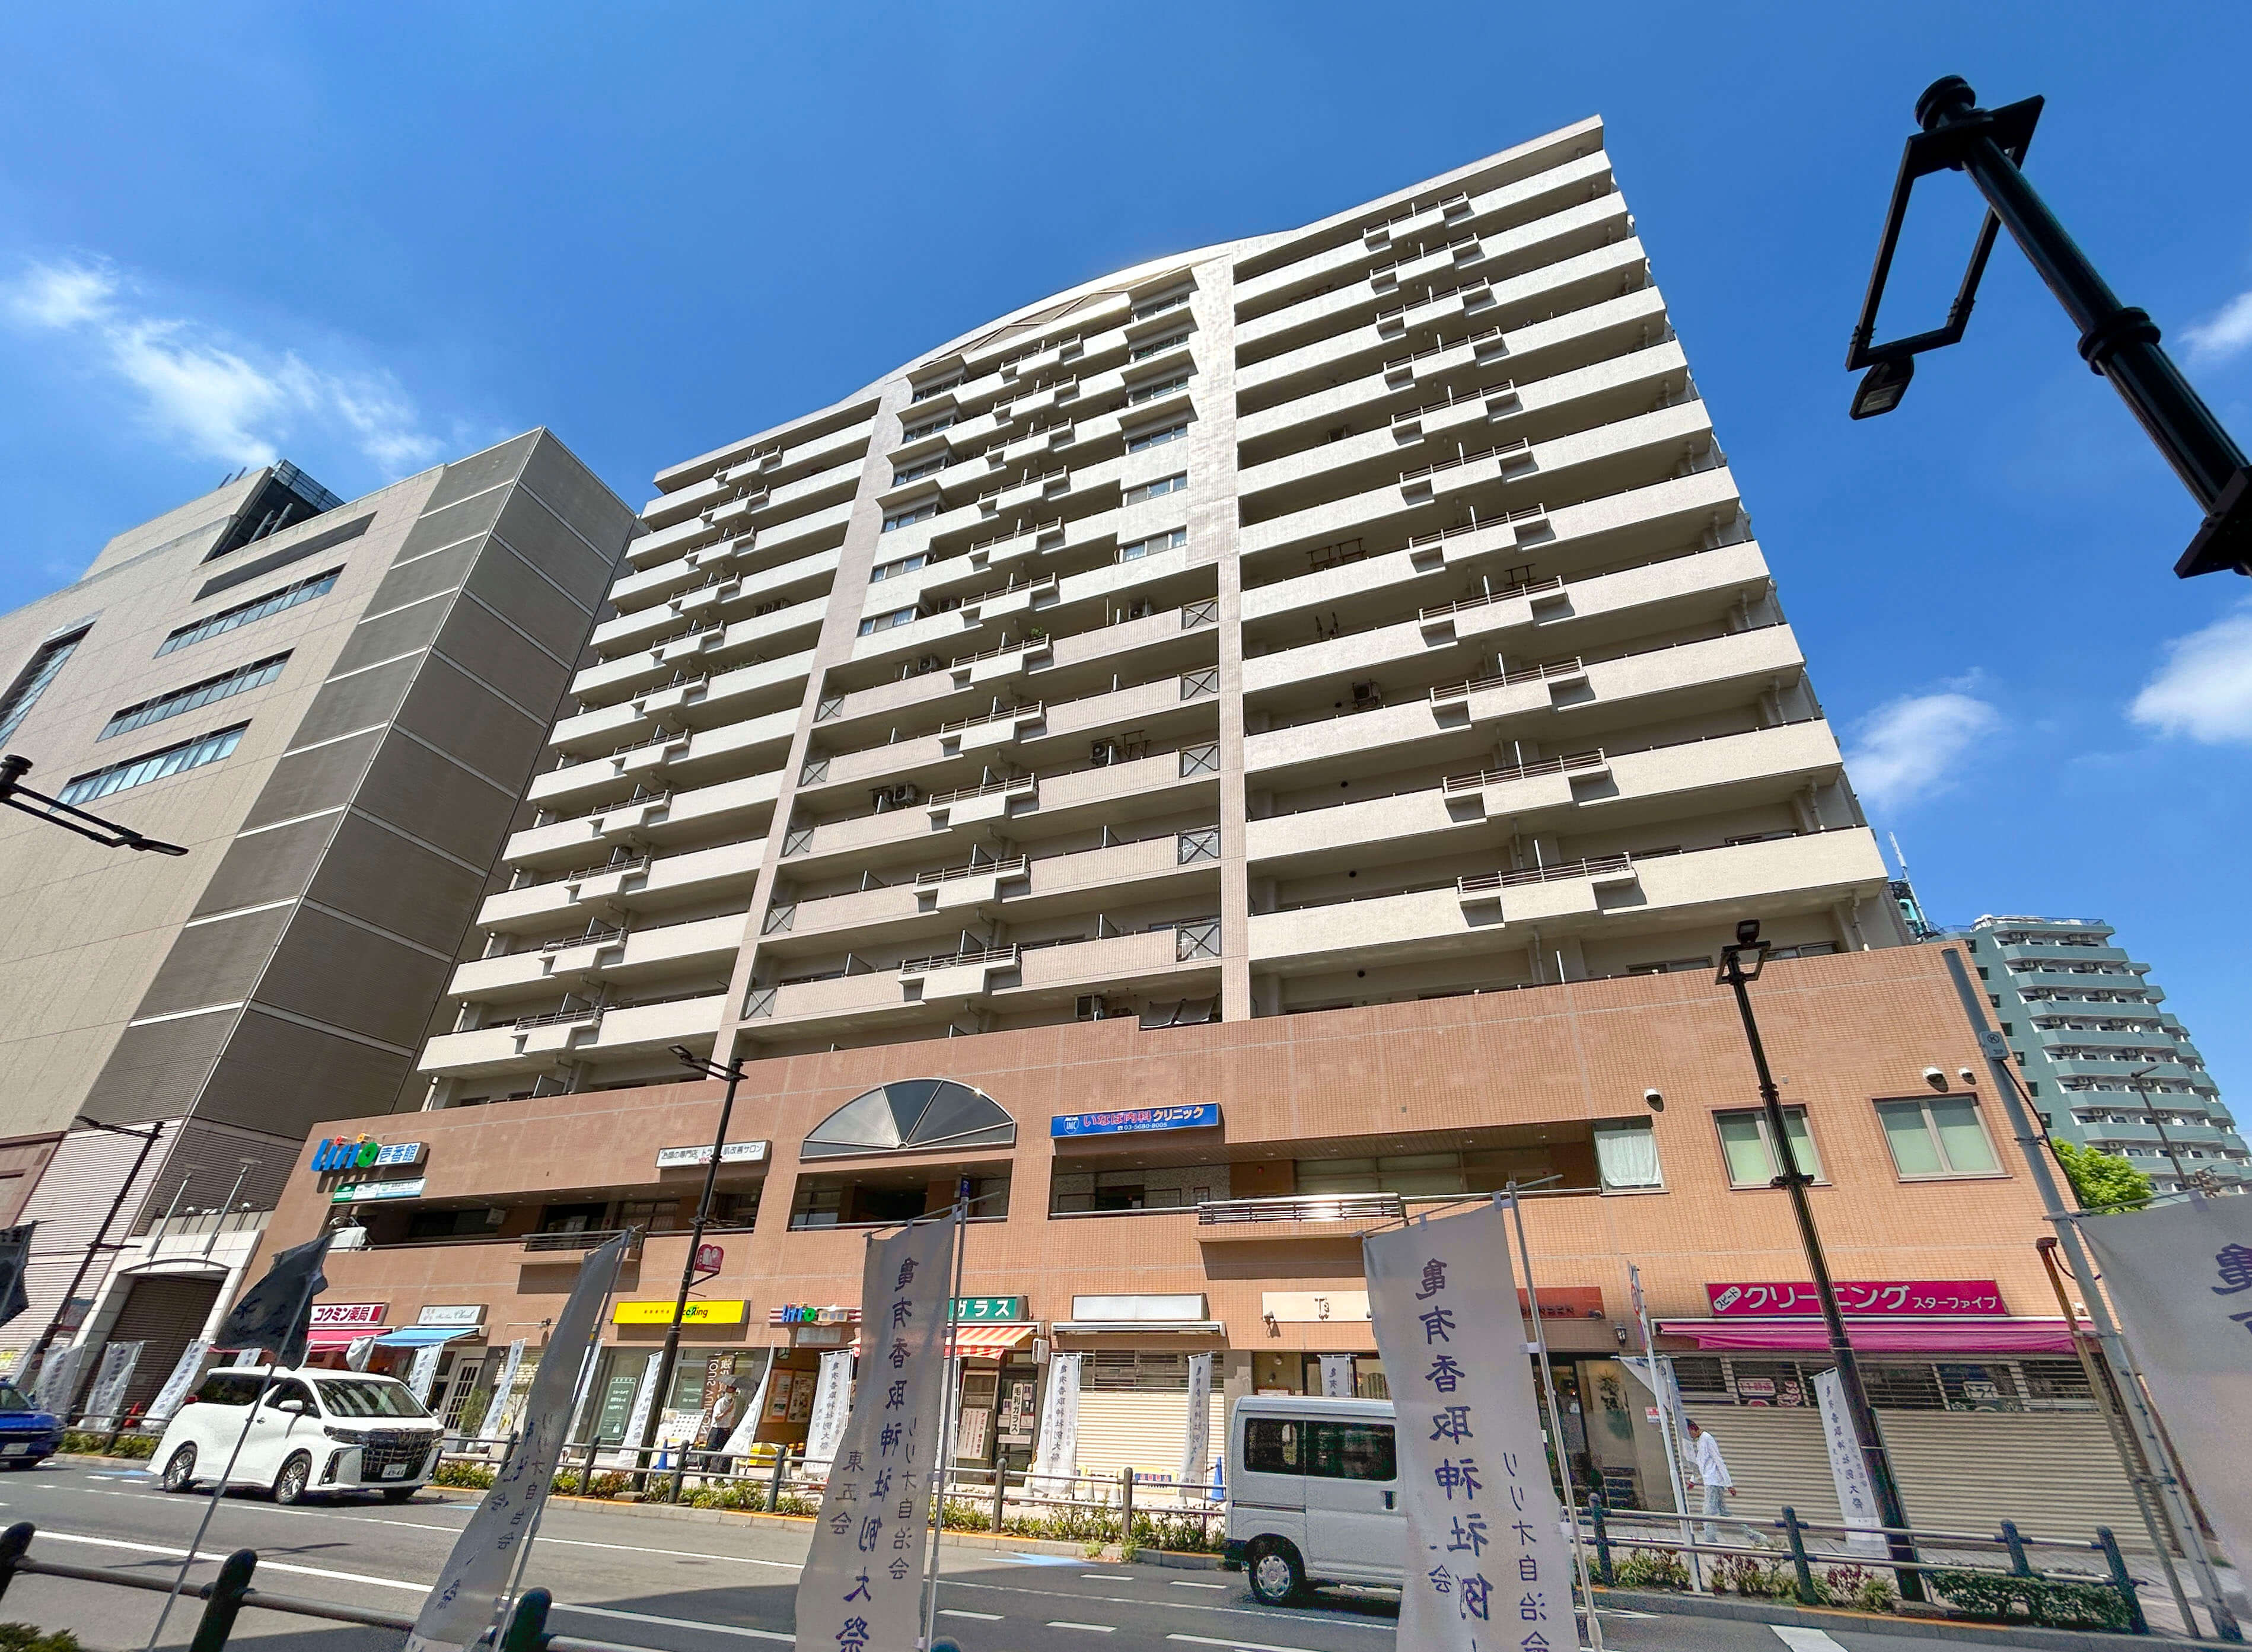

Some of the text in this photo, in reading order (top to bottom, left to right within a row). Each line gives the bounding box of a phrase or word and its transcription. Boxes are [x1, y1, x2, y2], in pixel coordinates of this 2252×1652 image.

[1716, 1289, 1740, 1309] スピード
[1911, 1296, 1997, 1309] スターファイブ
[314, 1306, 371, 1322] コクミン薬局
[682, 1306, 708, 1319] coRing
[1011, 1386, 1021, 1433] 毛利ガラス
